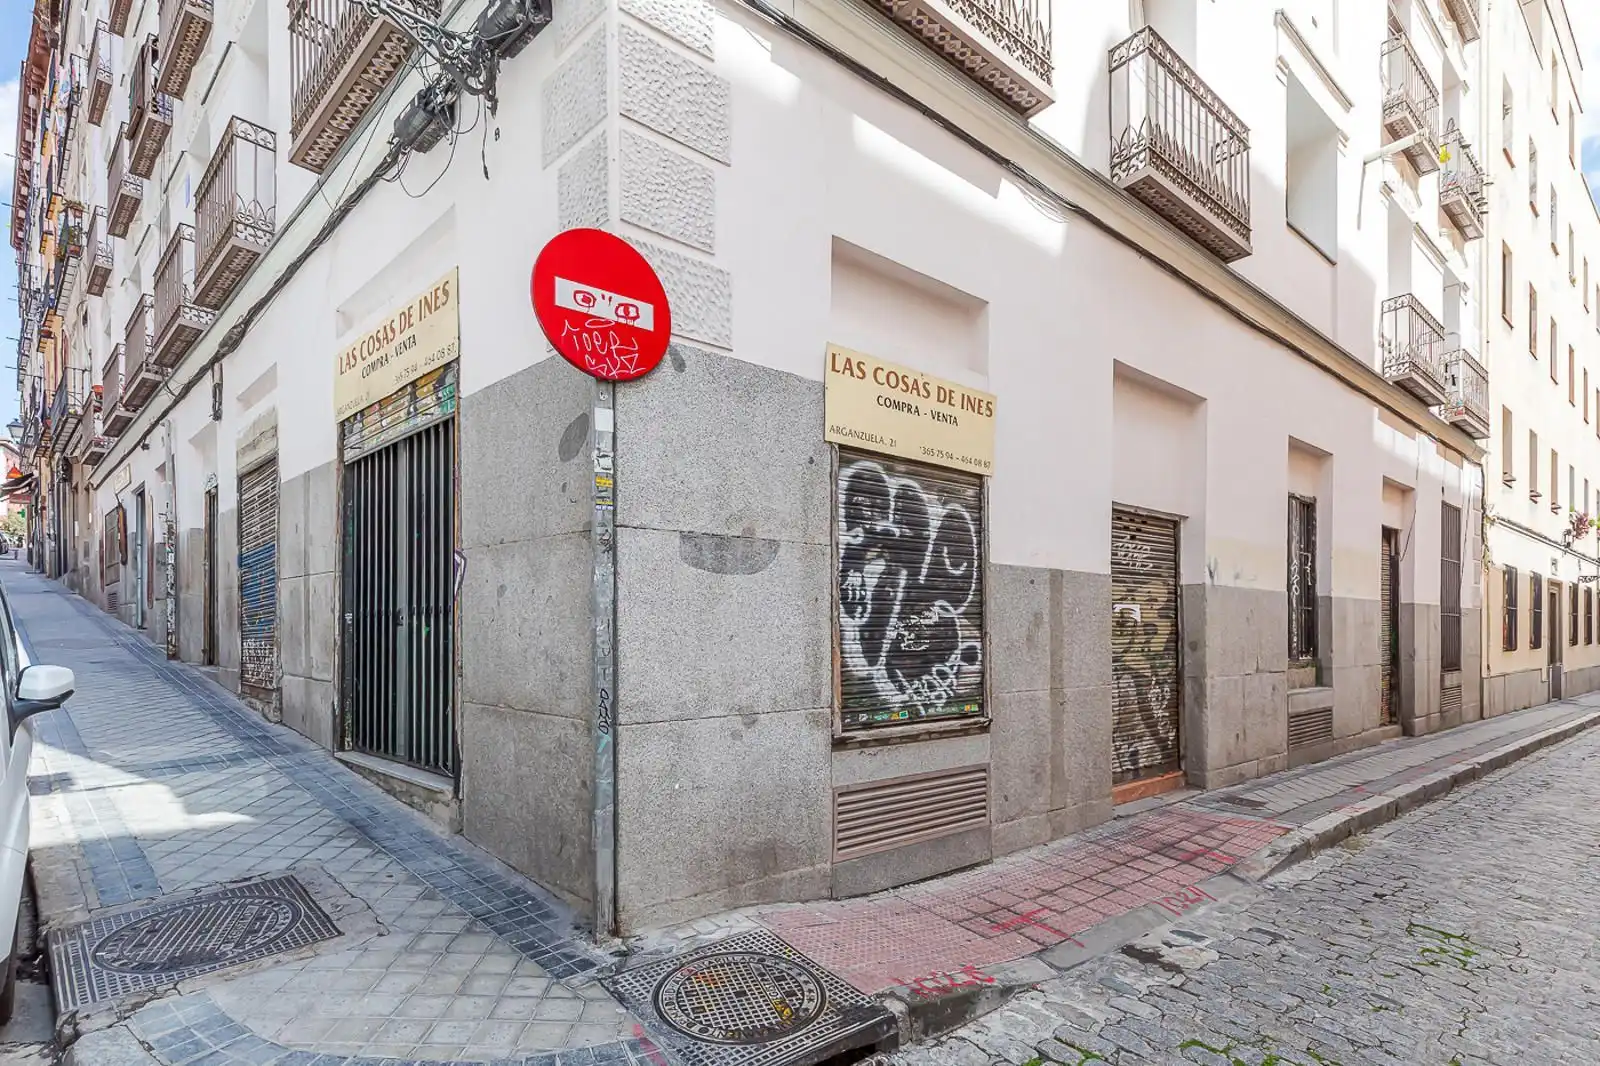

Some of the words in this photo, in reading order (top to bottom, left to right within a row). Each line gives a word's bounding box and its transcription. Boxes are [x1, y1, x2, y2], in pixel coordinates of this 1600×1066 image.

[338, 346, 357, 376] LAS
[360, 319, 396, 362] COSAS
[399, 305, 414, 335] DE
[418, 280, 450, 322] INES
[361, 352, 389, 379] COMPRA
[394, 334, 417, 358] VENTA
[831, 352, 867, 380] LAS
[872, 366, 931, 399] COSAS
[936, 385, 956, 407] DE
[960, 393, 993, 418] INES
[876, 394, 921, 417] COMPRA
[930, 409, 959, 427] VENTA
[889, 438, 897, 448] 21
